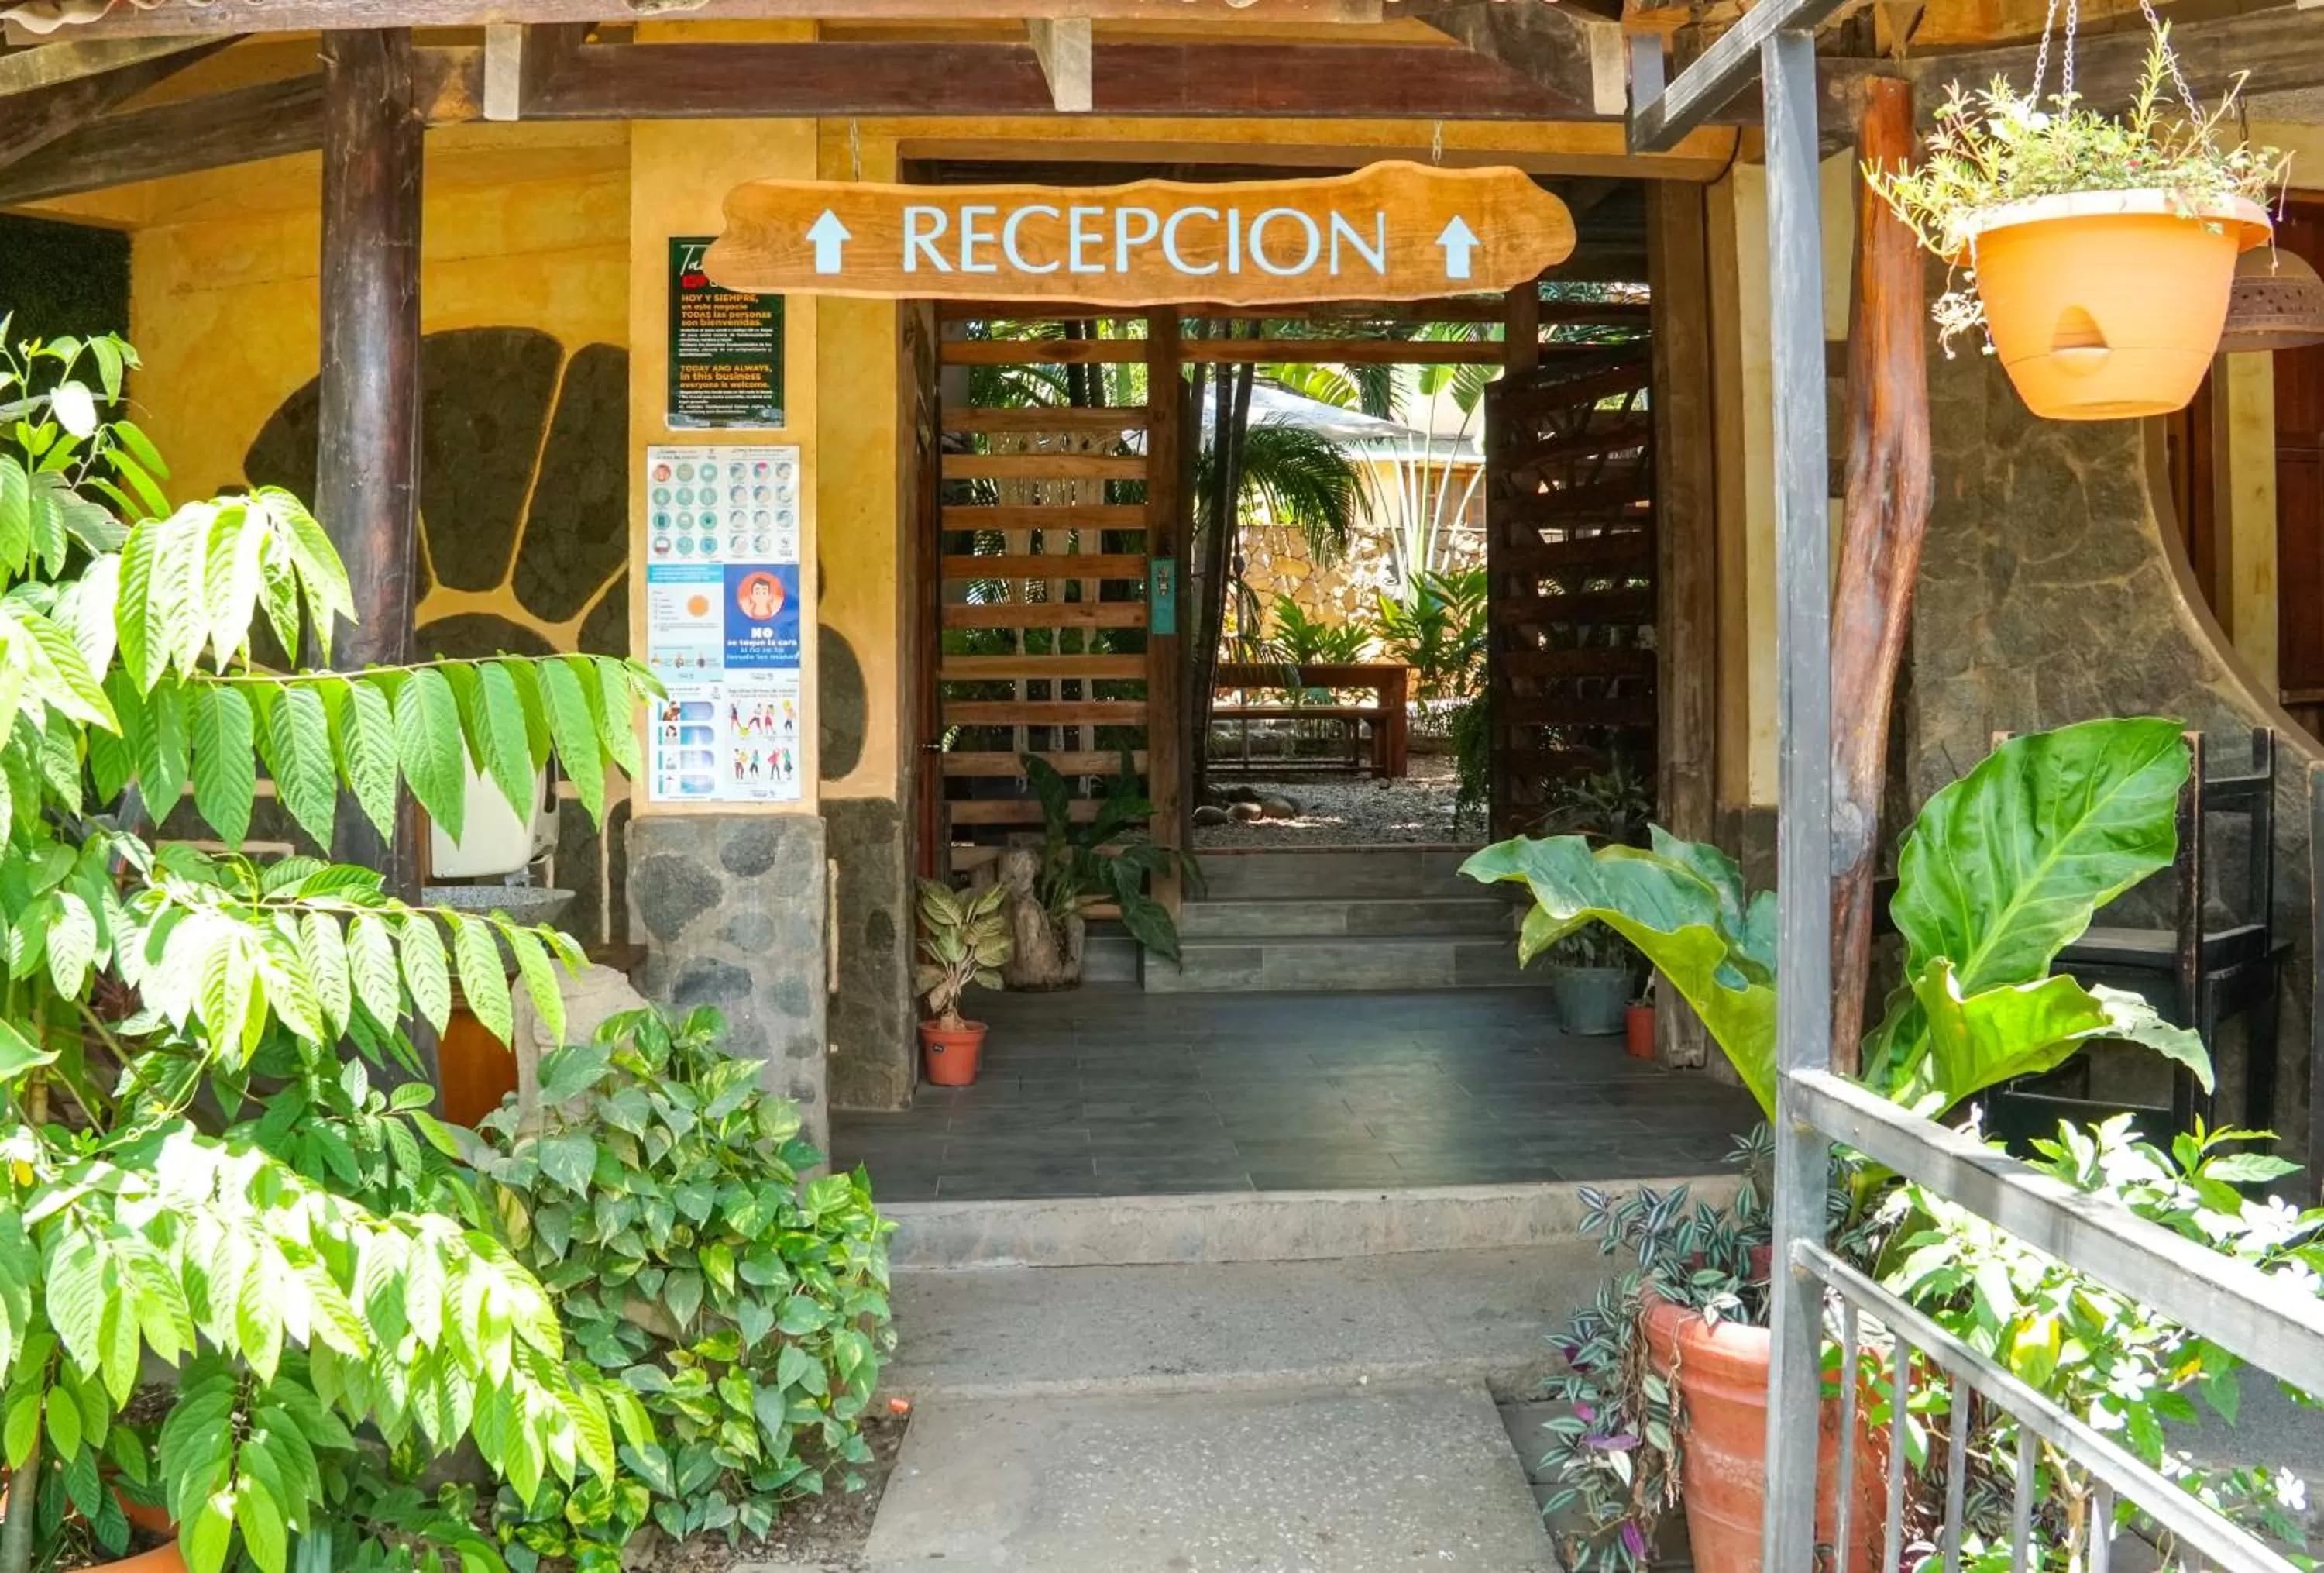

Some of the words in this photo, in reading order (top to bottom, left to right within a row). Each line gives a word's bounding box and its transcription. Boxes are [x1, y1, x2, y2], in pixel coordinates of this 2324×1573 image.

[902, 205, 1387, 276] RECEPCION
[713, 294, 758, 303] SIEMPRE,
[713, 303, 748, 312] negocio
[729, 311, 772, 320] personas
[751, 627, 774, 638] NO
